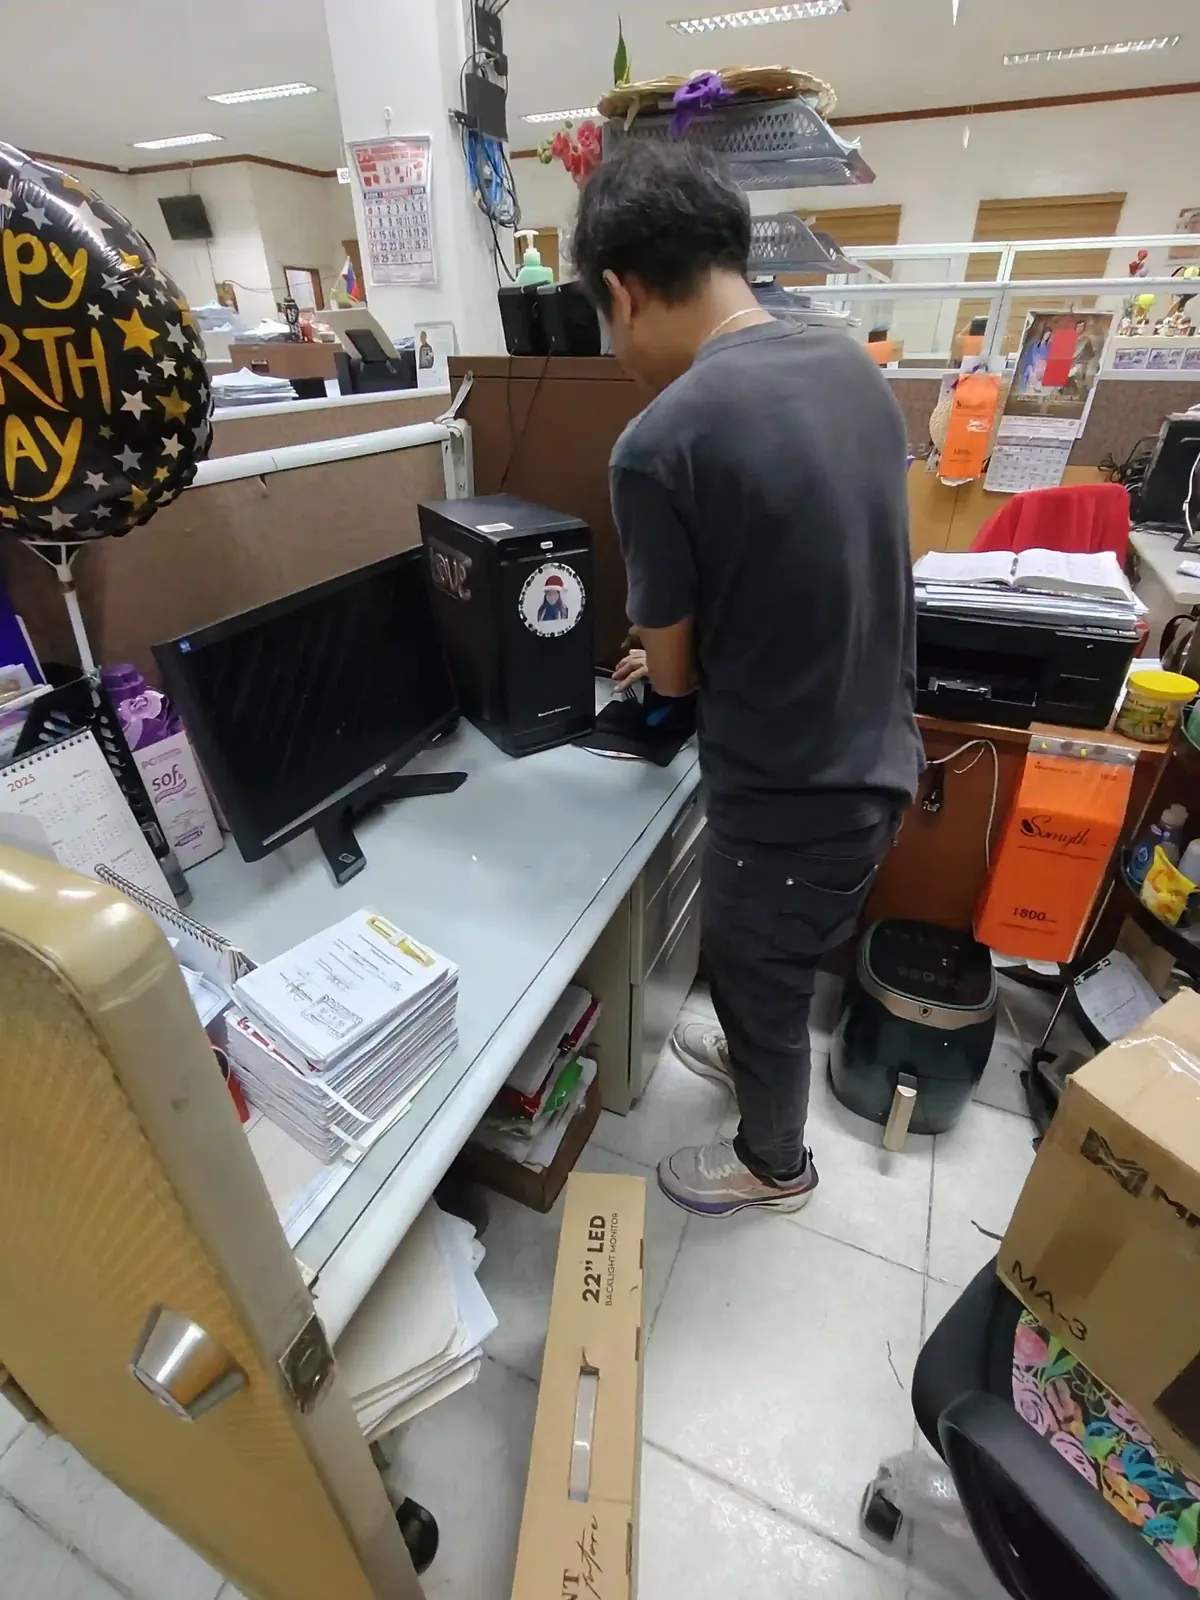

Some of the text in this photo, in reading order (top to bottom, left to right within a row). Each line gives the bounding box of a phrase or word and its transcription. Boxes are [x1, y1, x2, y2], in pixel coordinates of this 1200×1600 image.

[7, 774, 36, 792] 2025
[1013, 906, 1047, 922] 1800
[587, 1215, 606, 1254] LED
[605, 1212, 619, 1306] BACKLIGHT MONITOR
